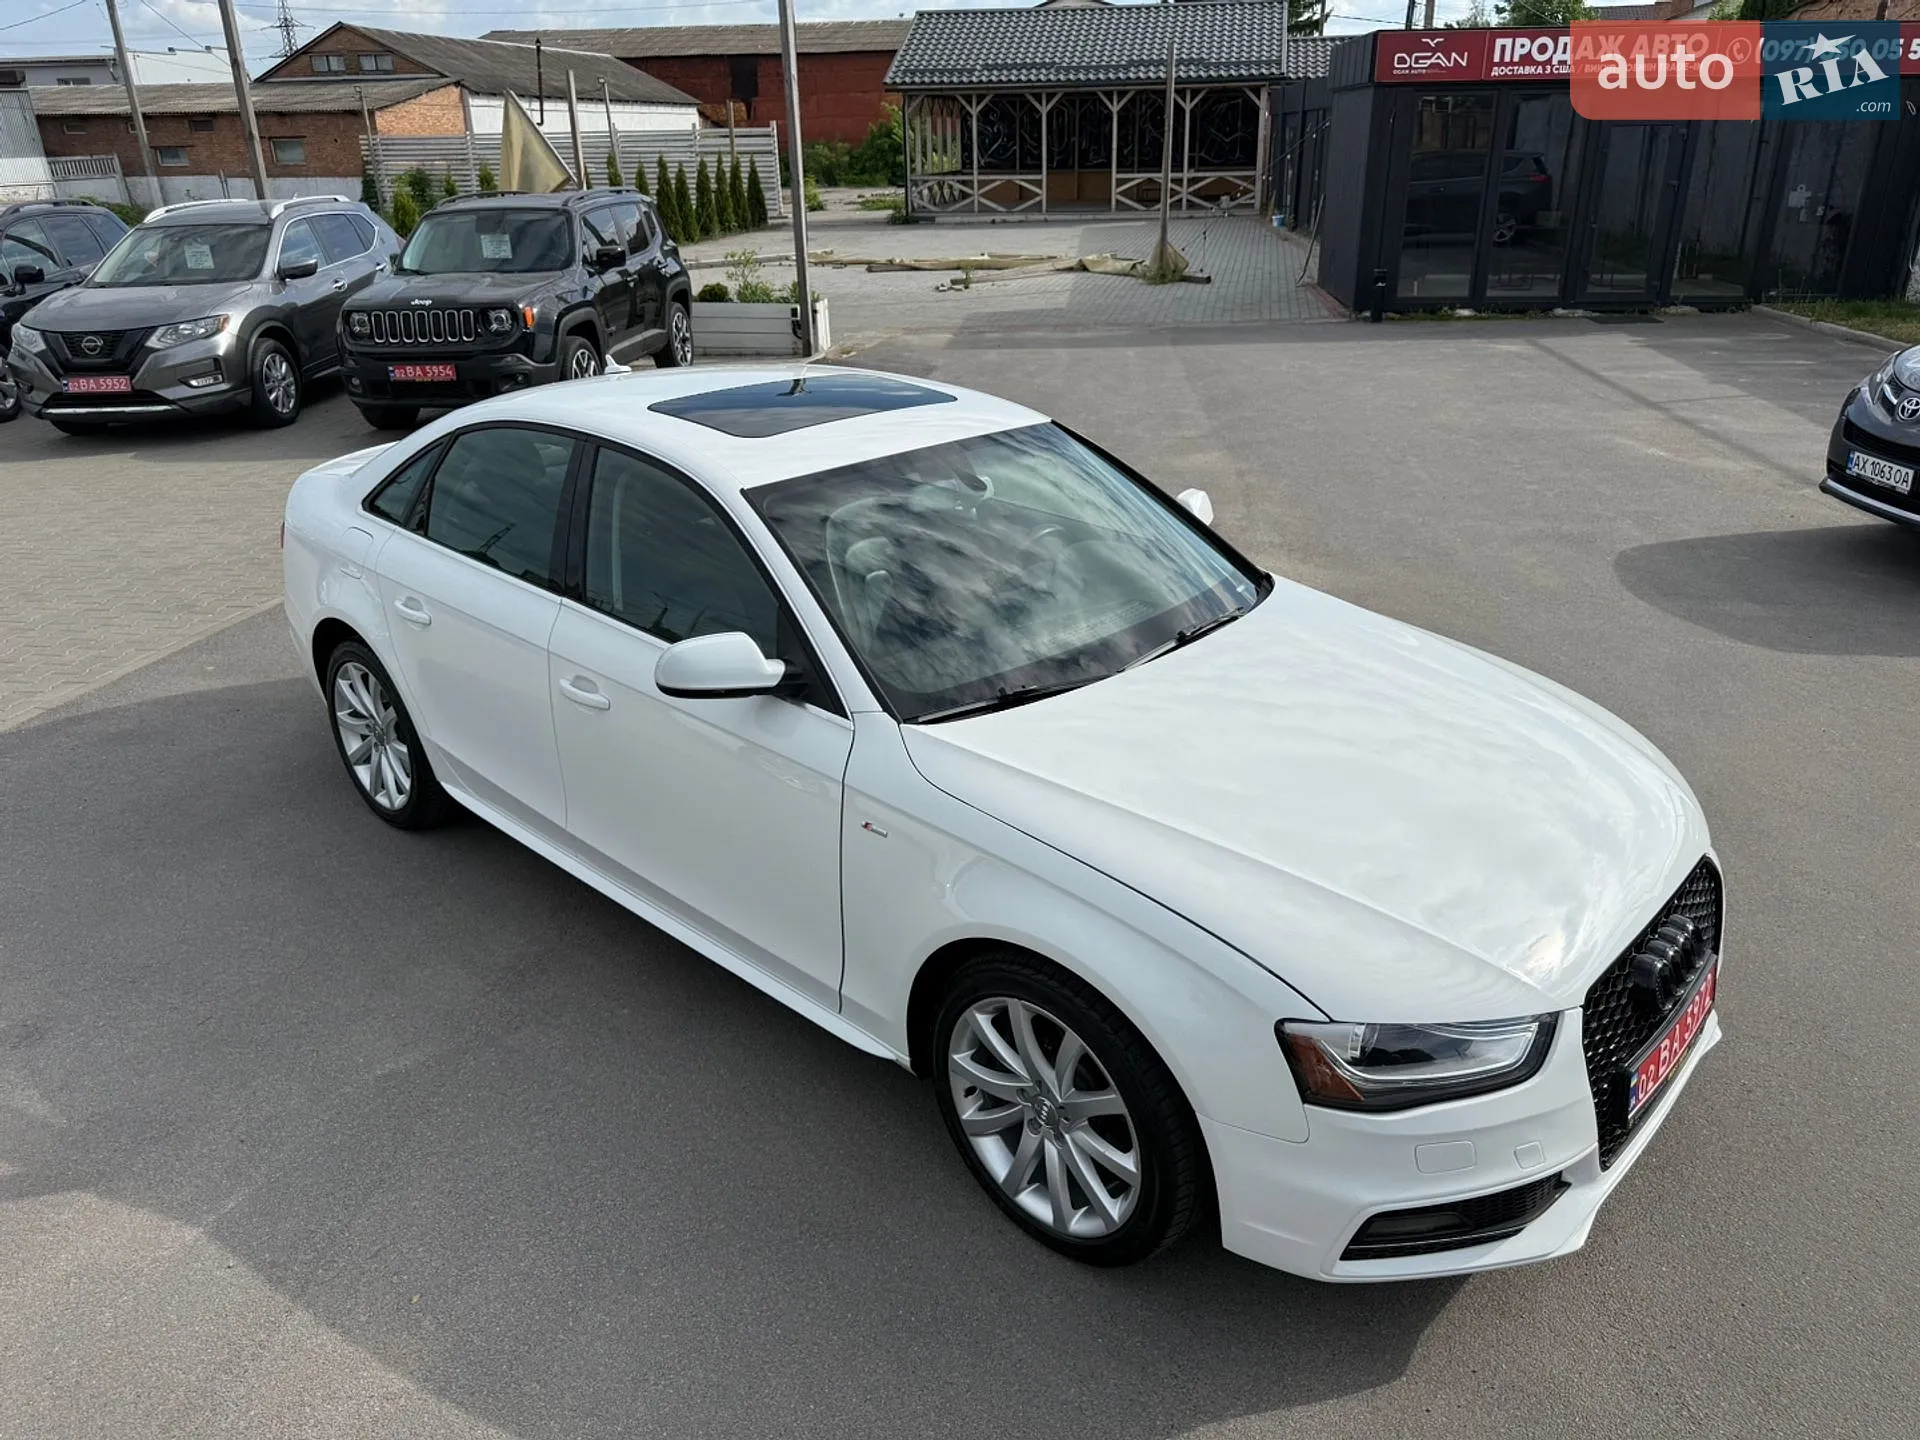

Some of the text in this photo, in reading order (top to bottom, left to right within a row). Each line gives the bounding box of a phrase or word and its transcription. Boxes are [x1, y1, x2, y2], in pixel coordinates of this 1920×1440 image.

[1493, 33, 1709, 65] ПРОДАЖ АВТО
[1491, 65, 1543, 77] ДОСТАВКА
[100, 378, 128, 390] 5952
